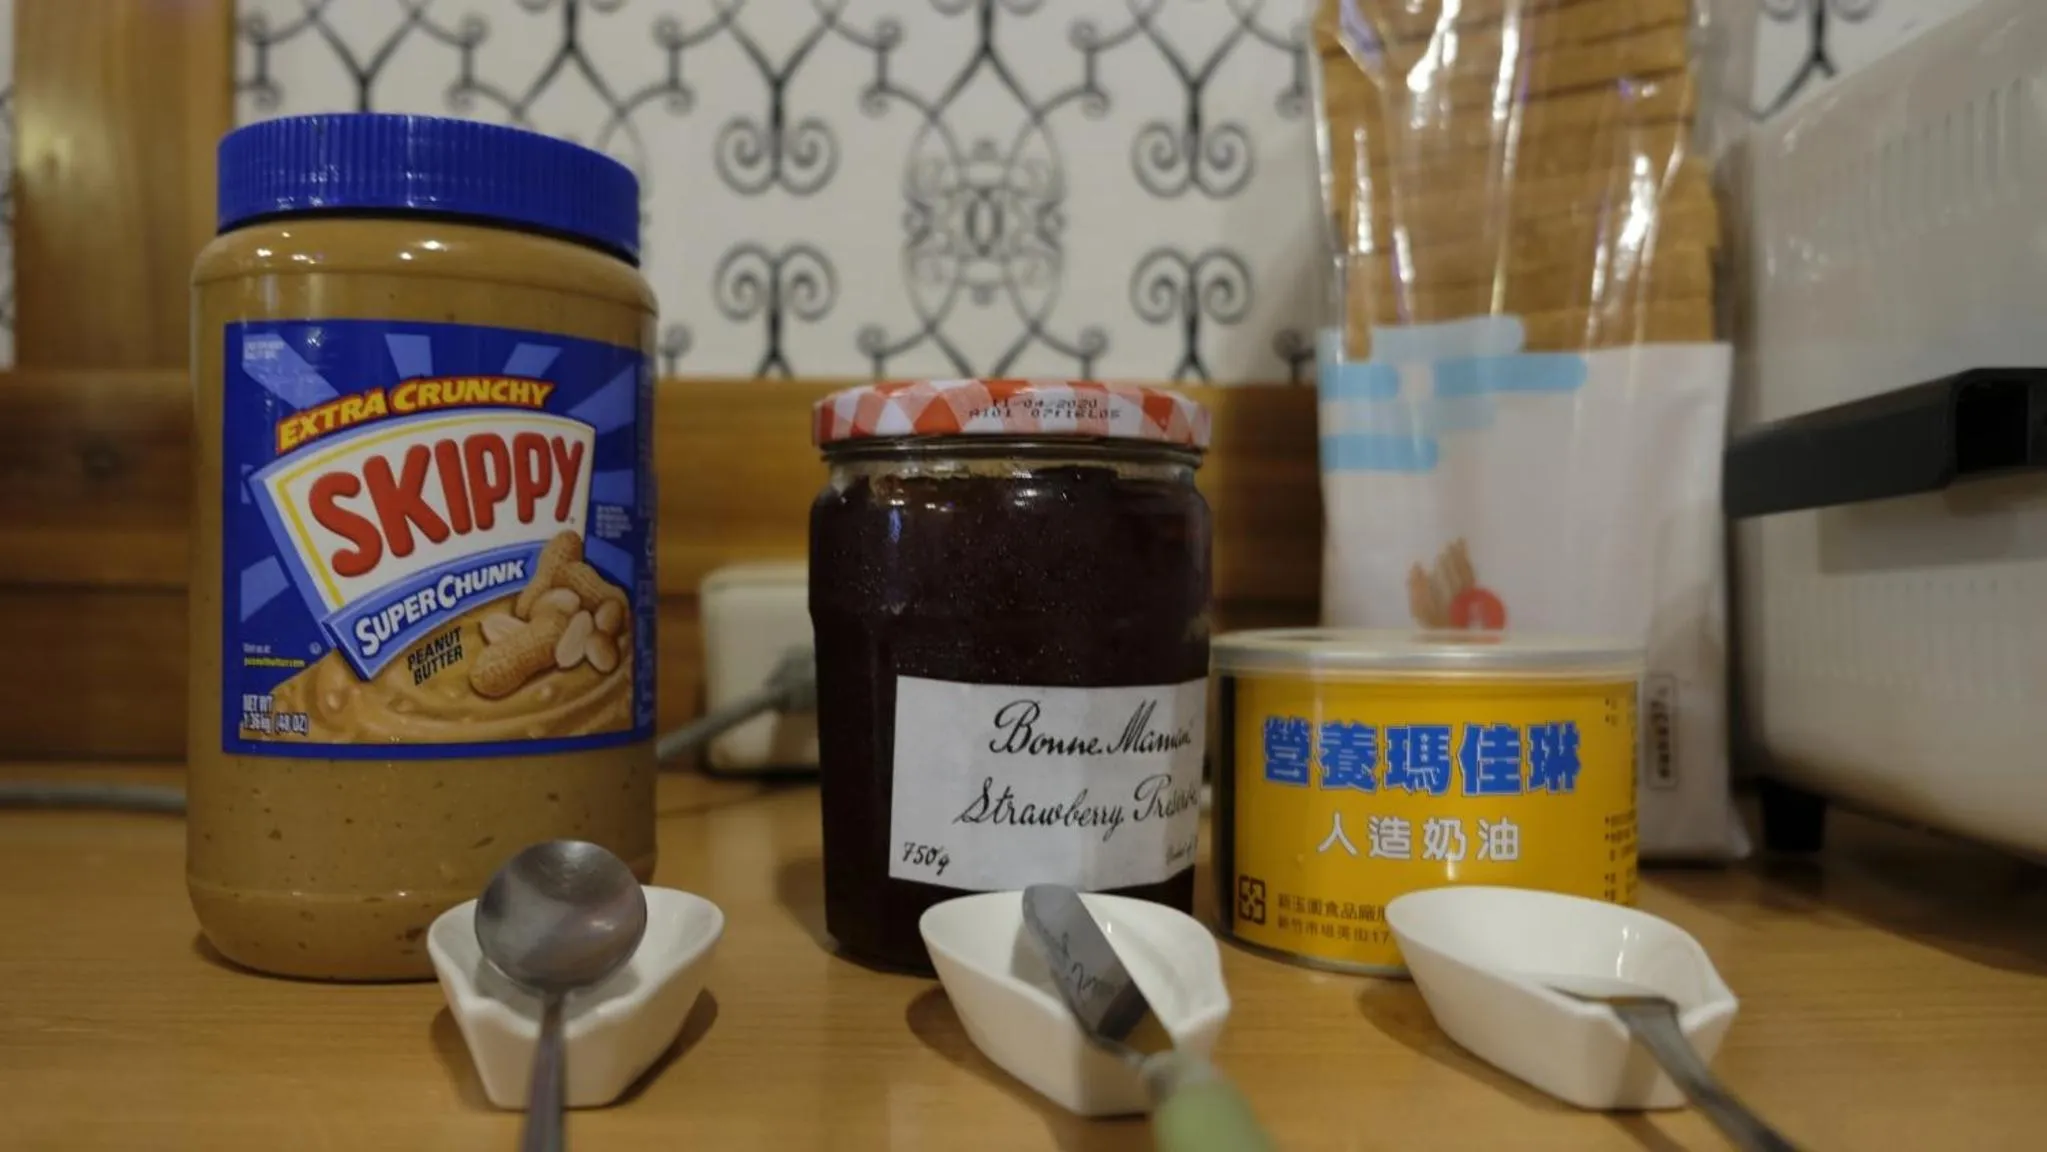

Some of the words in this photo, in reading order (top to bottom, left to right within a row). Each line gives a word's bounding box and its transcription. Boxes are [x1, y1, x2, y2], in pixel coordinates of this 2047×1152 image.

[280, 387, 390, 452] EXTRA
[393, 378, 552, 411] CRUNCHY
[309, 432, 583, 578] SKIPPY
[407, 626, 462, 670] PEANUT
[414, 645, 464, 686] BUTTER
[989, 699, 1103, 754] Bonne
[1262, 715, 1582, 797] 營養瑪佳琳
[952, 776, 1125, 842] Strawberry
[1316, 812, 1520, 862] 人造奶油
